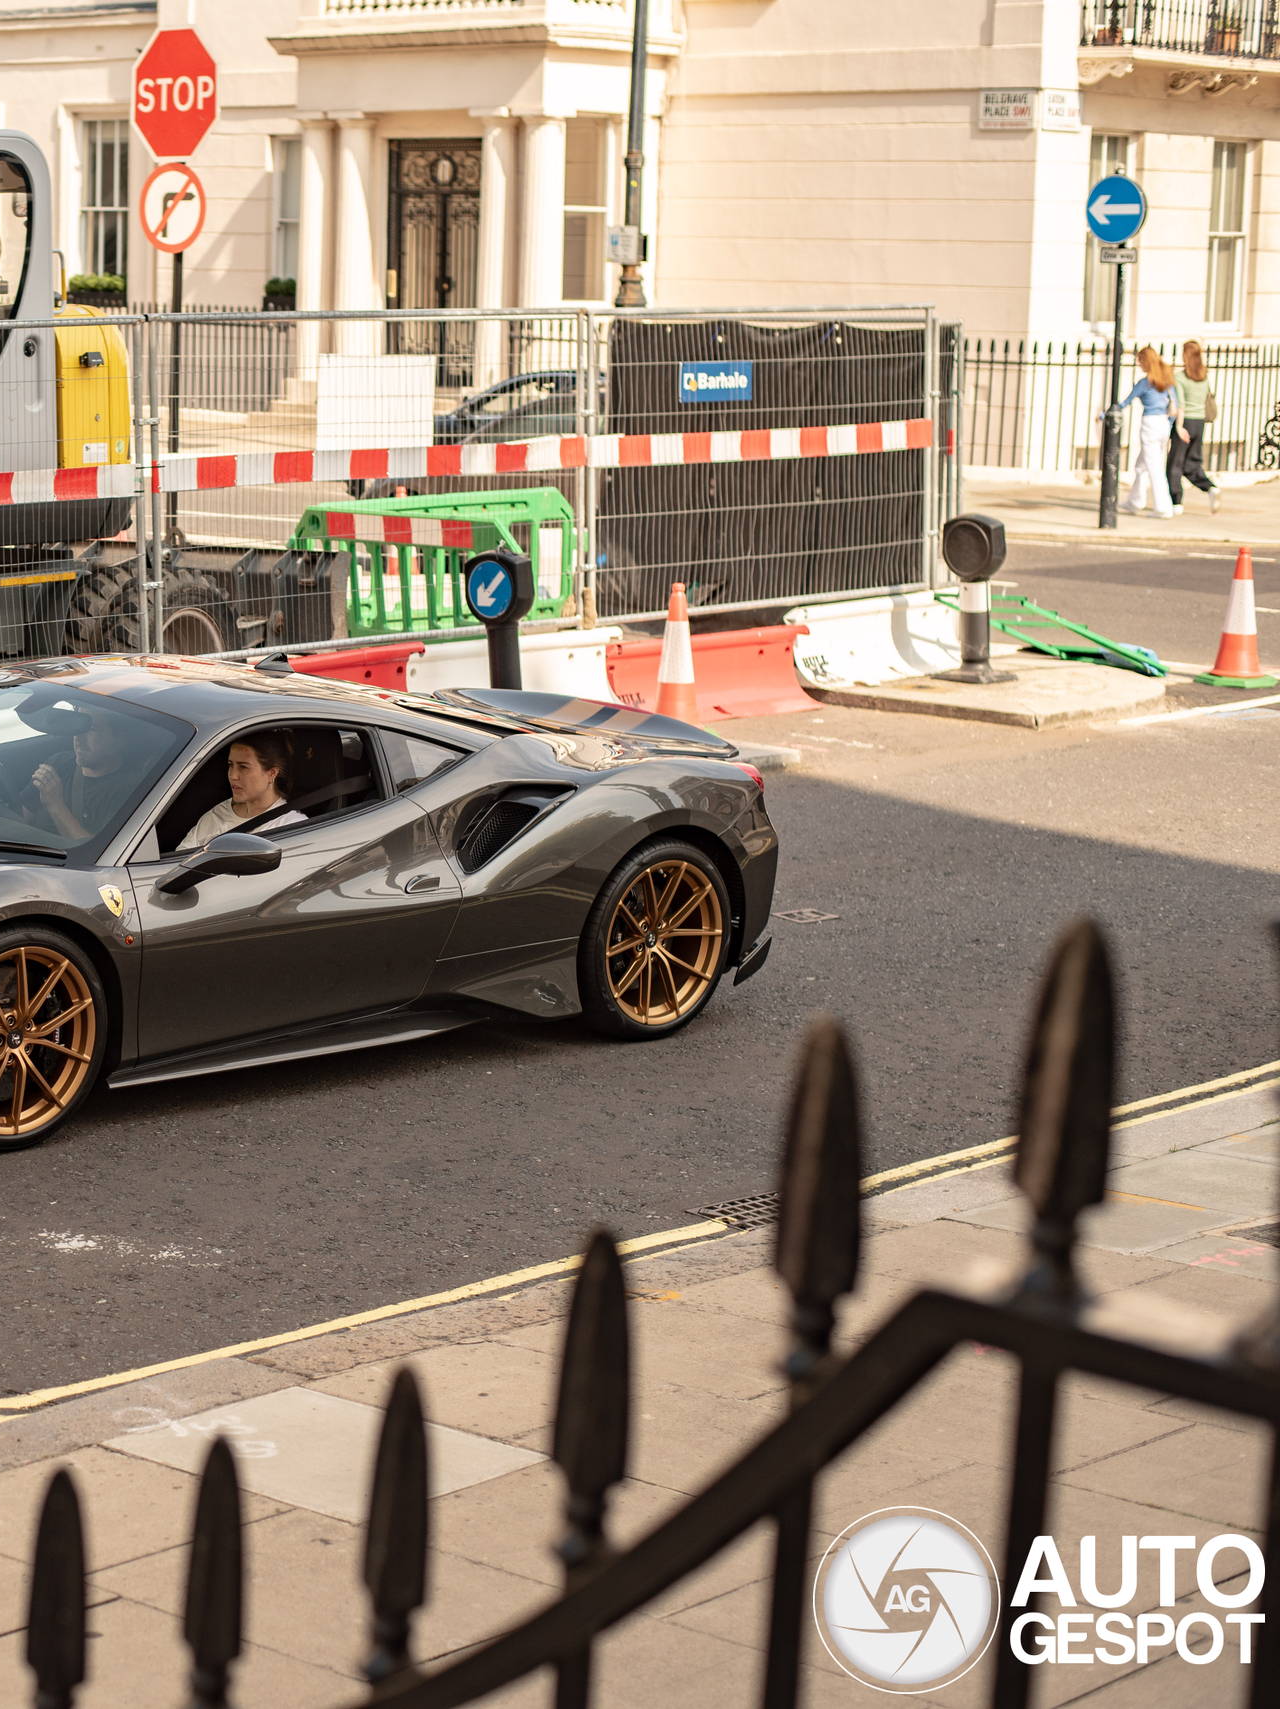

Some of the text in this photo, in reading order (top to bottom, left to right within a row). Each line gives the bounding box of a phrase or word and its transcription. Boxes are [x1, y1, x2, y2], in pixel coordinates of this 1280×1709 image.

[137, 75, 215, 113] STOP
[984, 106, 1009, 116] PLACE
[697, 371, 748, 390] Barhale
[802, 655, 829, 670] BULL
